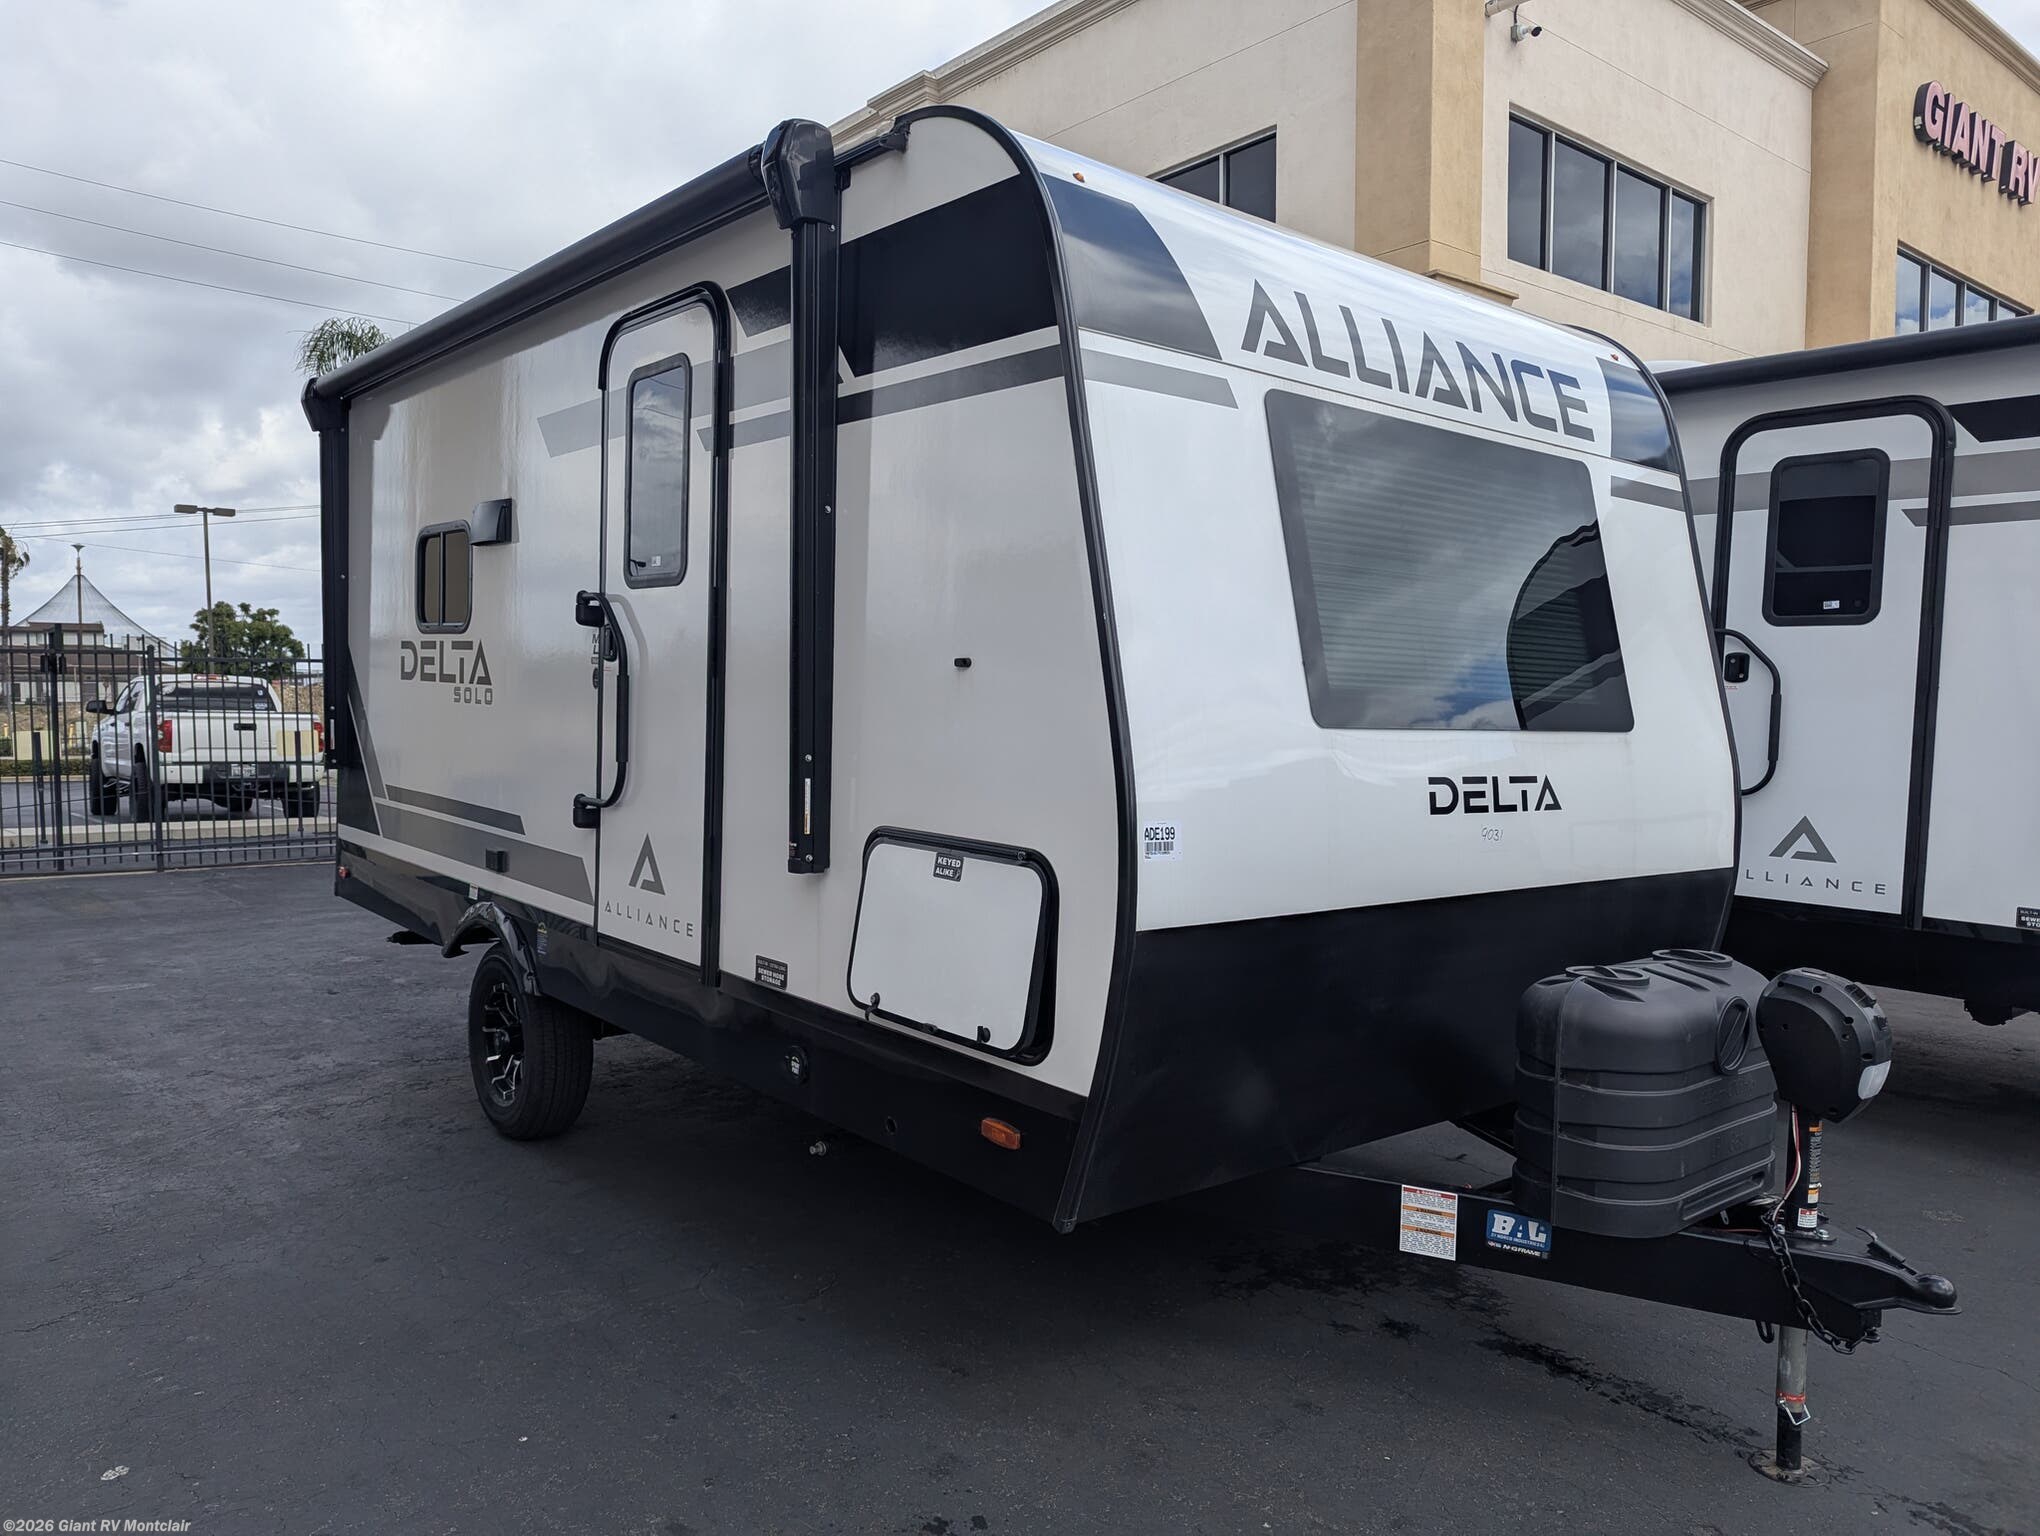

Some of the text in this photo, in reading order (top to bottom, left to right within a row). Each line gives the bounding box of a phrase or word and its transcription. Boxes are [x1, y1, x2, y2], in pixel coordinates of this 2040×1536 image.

[1914, 80, 2040, 205] GIANT RV
[1241, 278, 1595, 442] ALLIANCE
[400, 639, 492, 686] DELTA
[454, 686, 493, 705] SOLO
[1428, 774, 1562, 815] DELTA
[1144, 826, 1176, 841] ADE199
[935, 867, 954, 877] ALIKE
[937, 856, 961, 868] KEYED
[1746, 869, 1887, 895] LLIANCE
[605, 901, 694, 937] ALLIANCE
